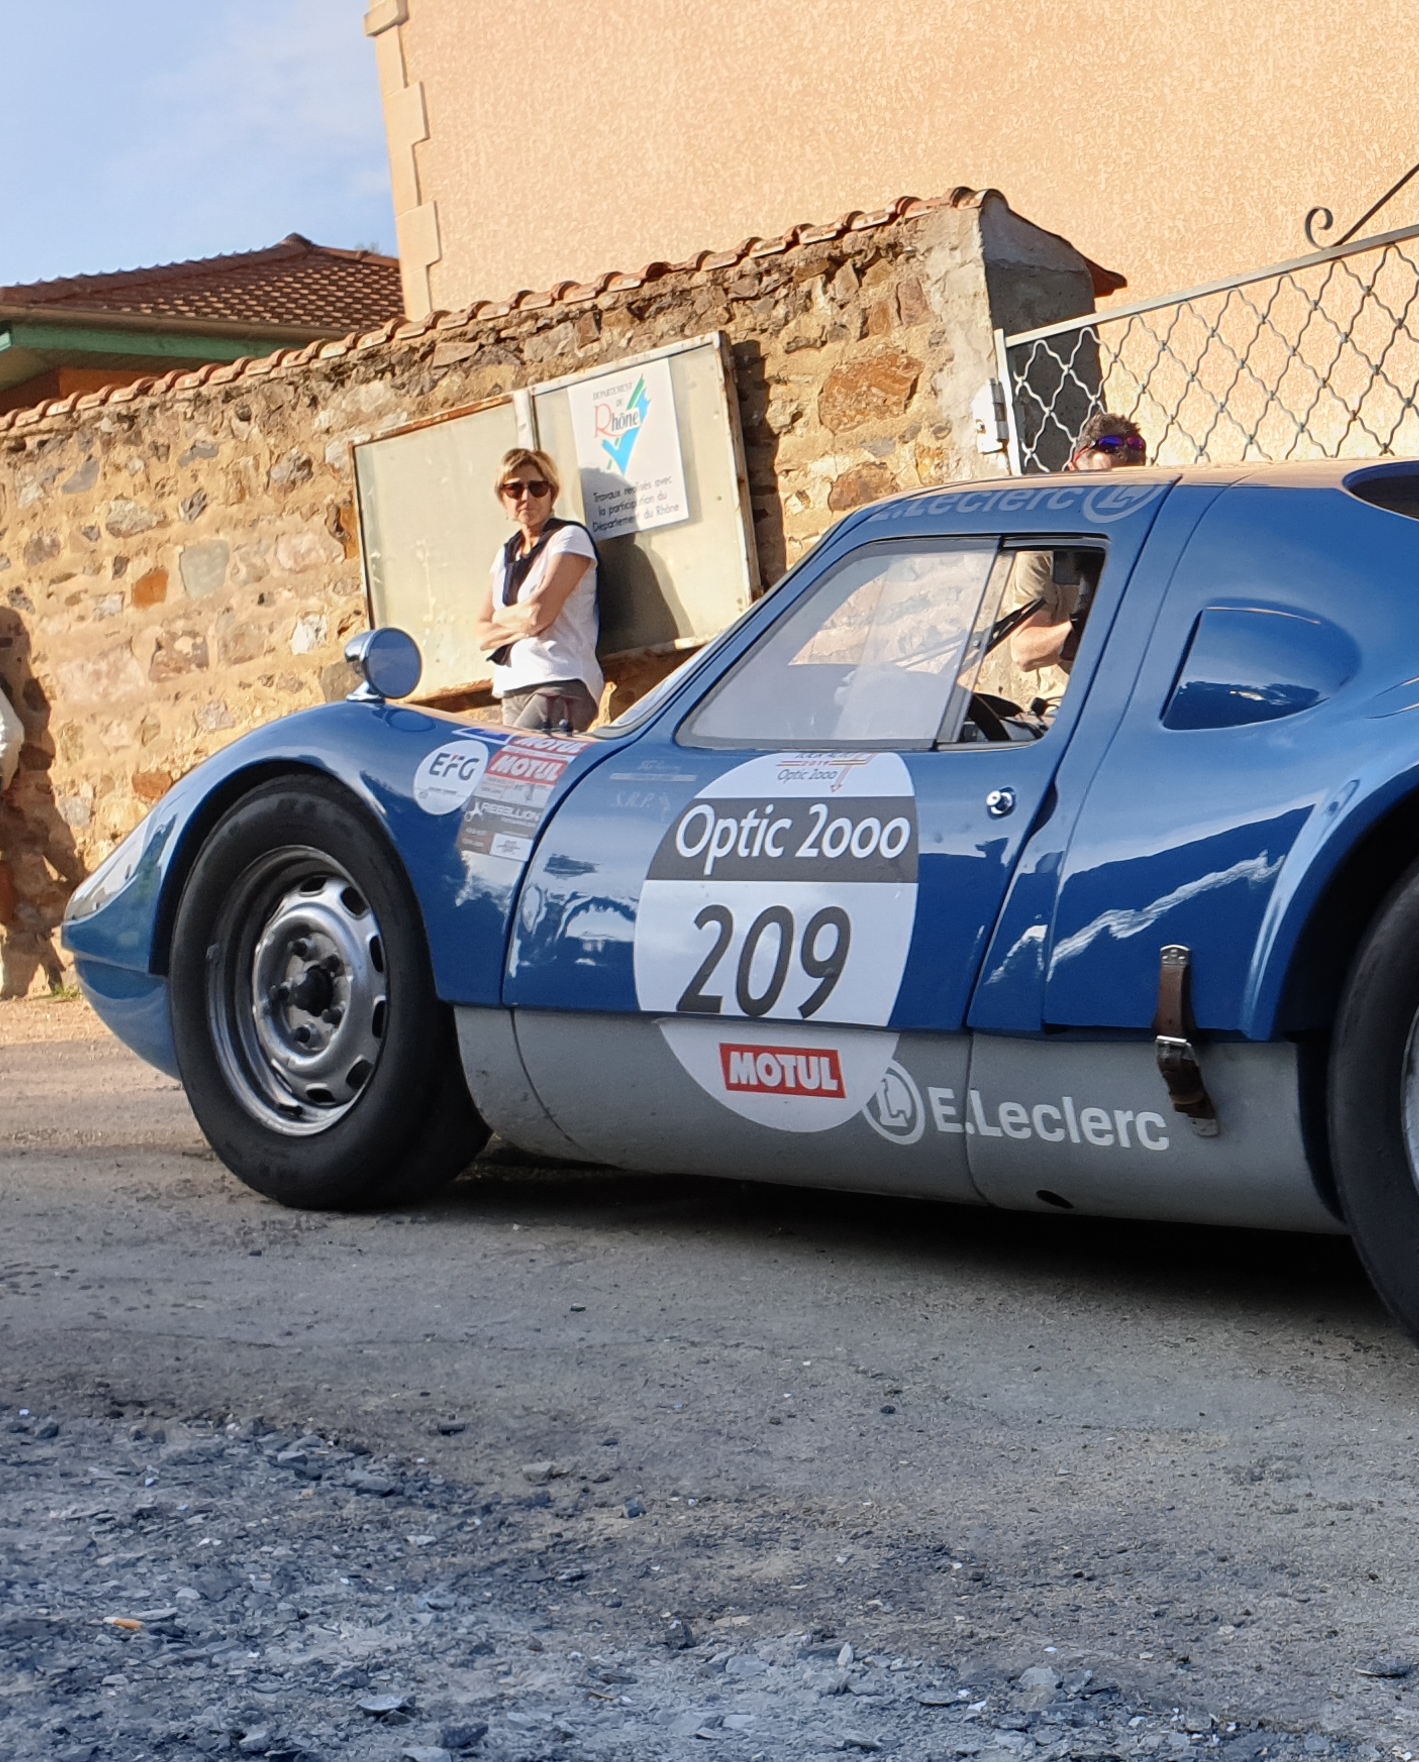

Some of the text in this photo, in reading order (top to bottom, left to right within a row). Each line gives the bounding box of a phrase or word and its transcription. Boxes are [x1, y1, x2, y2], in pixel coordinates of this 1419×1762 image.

[594, 403, 639, 438] Rhône
[593, 488, 621, 503] Travaux
[429, 752, 480, 781] EFG
[489, 754, 564, 782] MOTUL
[674, 803, 911, 876] Optic 2000
[675, 904, 853, 1019] 209
[729, 1051, 839, 1091] MOTUL
[927, 1086, 1170, 1151] E.Leclerc
